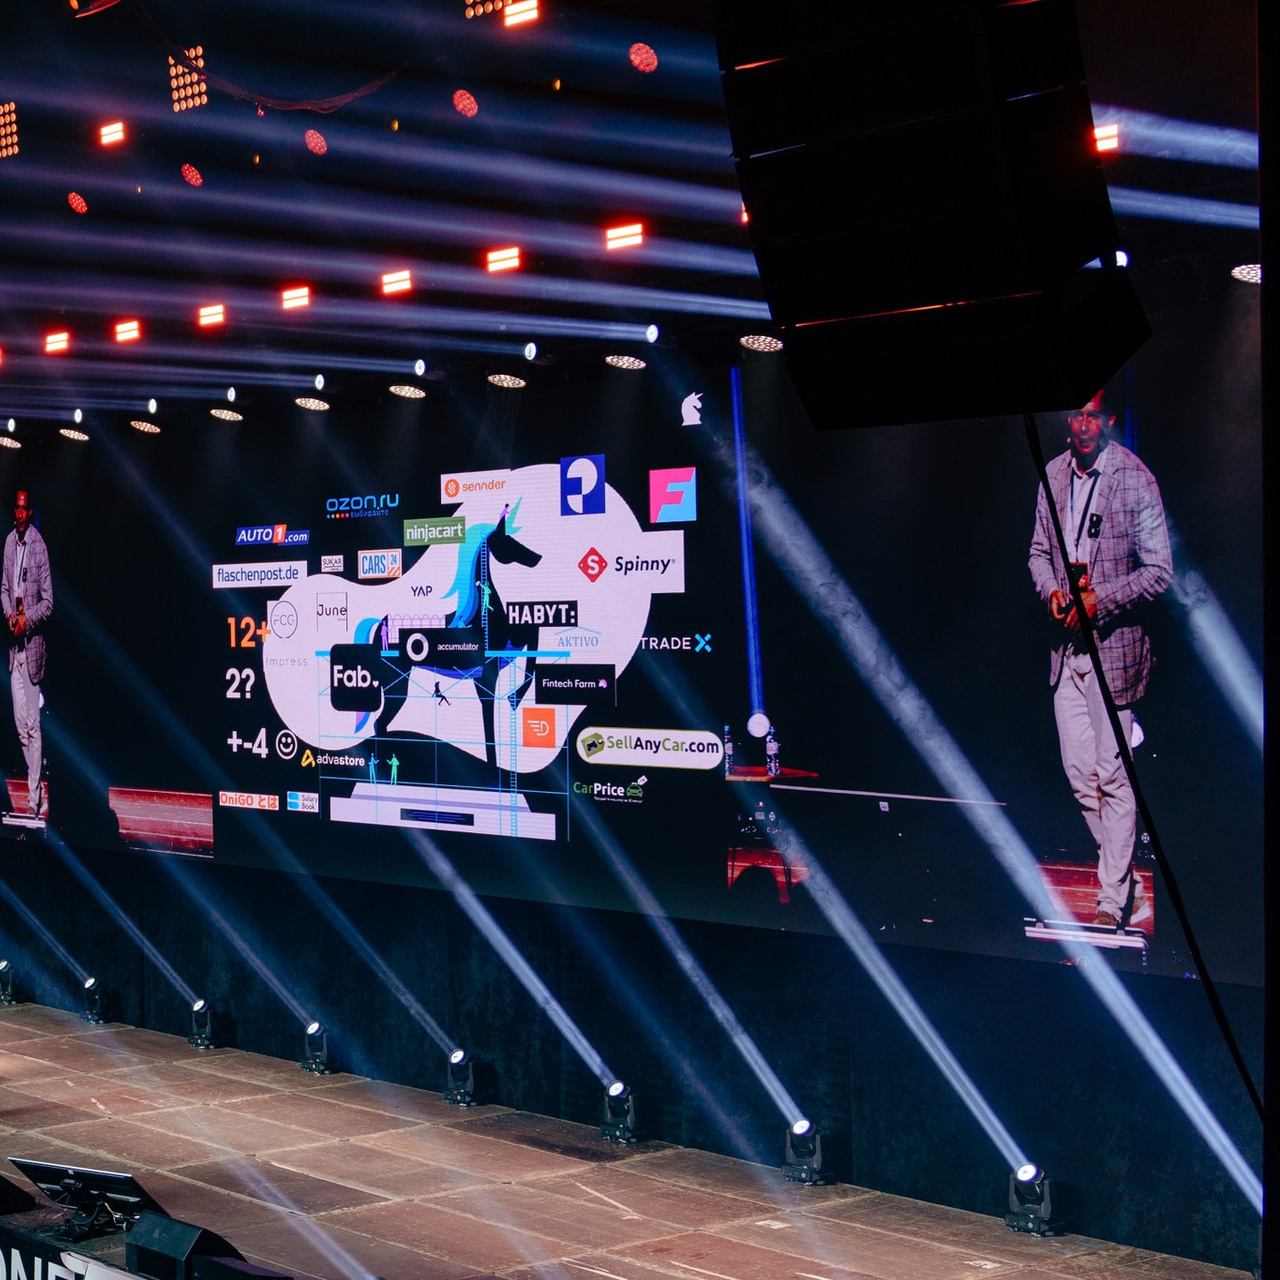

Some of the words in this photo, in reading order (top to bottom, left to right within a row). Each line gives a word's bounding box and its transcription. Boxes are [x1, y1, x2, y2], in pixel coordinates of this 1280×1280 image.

[462, 479, 506, 492] sennder
[326, 494, 399, 511] ozon.ru
[237, 526, 308, 542] AUTO1.com
[406, 523, 463, 542] ninjacart
[361, 554, 386, 575] CARS
[614, 555, 671, 576] Spinny
[217, 565, 299, 584] flaschenpost.de
[411, 586, 433, 597] YAP
[317, 604, 347, 616] June
[227, 616, 271, 648] 12+
[437, 642, 479, 651] accumulator
[557, 636, 599, 647] AKTIVO
[265, 657, 308, 667] Impress
[225, 668, 255, 699] 2?
[542, 679, 573, 688] Fintech
[575, 680, 596, 688] Farm
[607, 735, 719, 754] SellAnyCar.com
[316, 753, 366, 767] advastore
[573, 781, 625, 797] CarPrice
[220, 792, 254, 807] OniGO
[302, 794, 318, 803] Salary
[302, 802, 316, 811] Book
